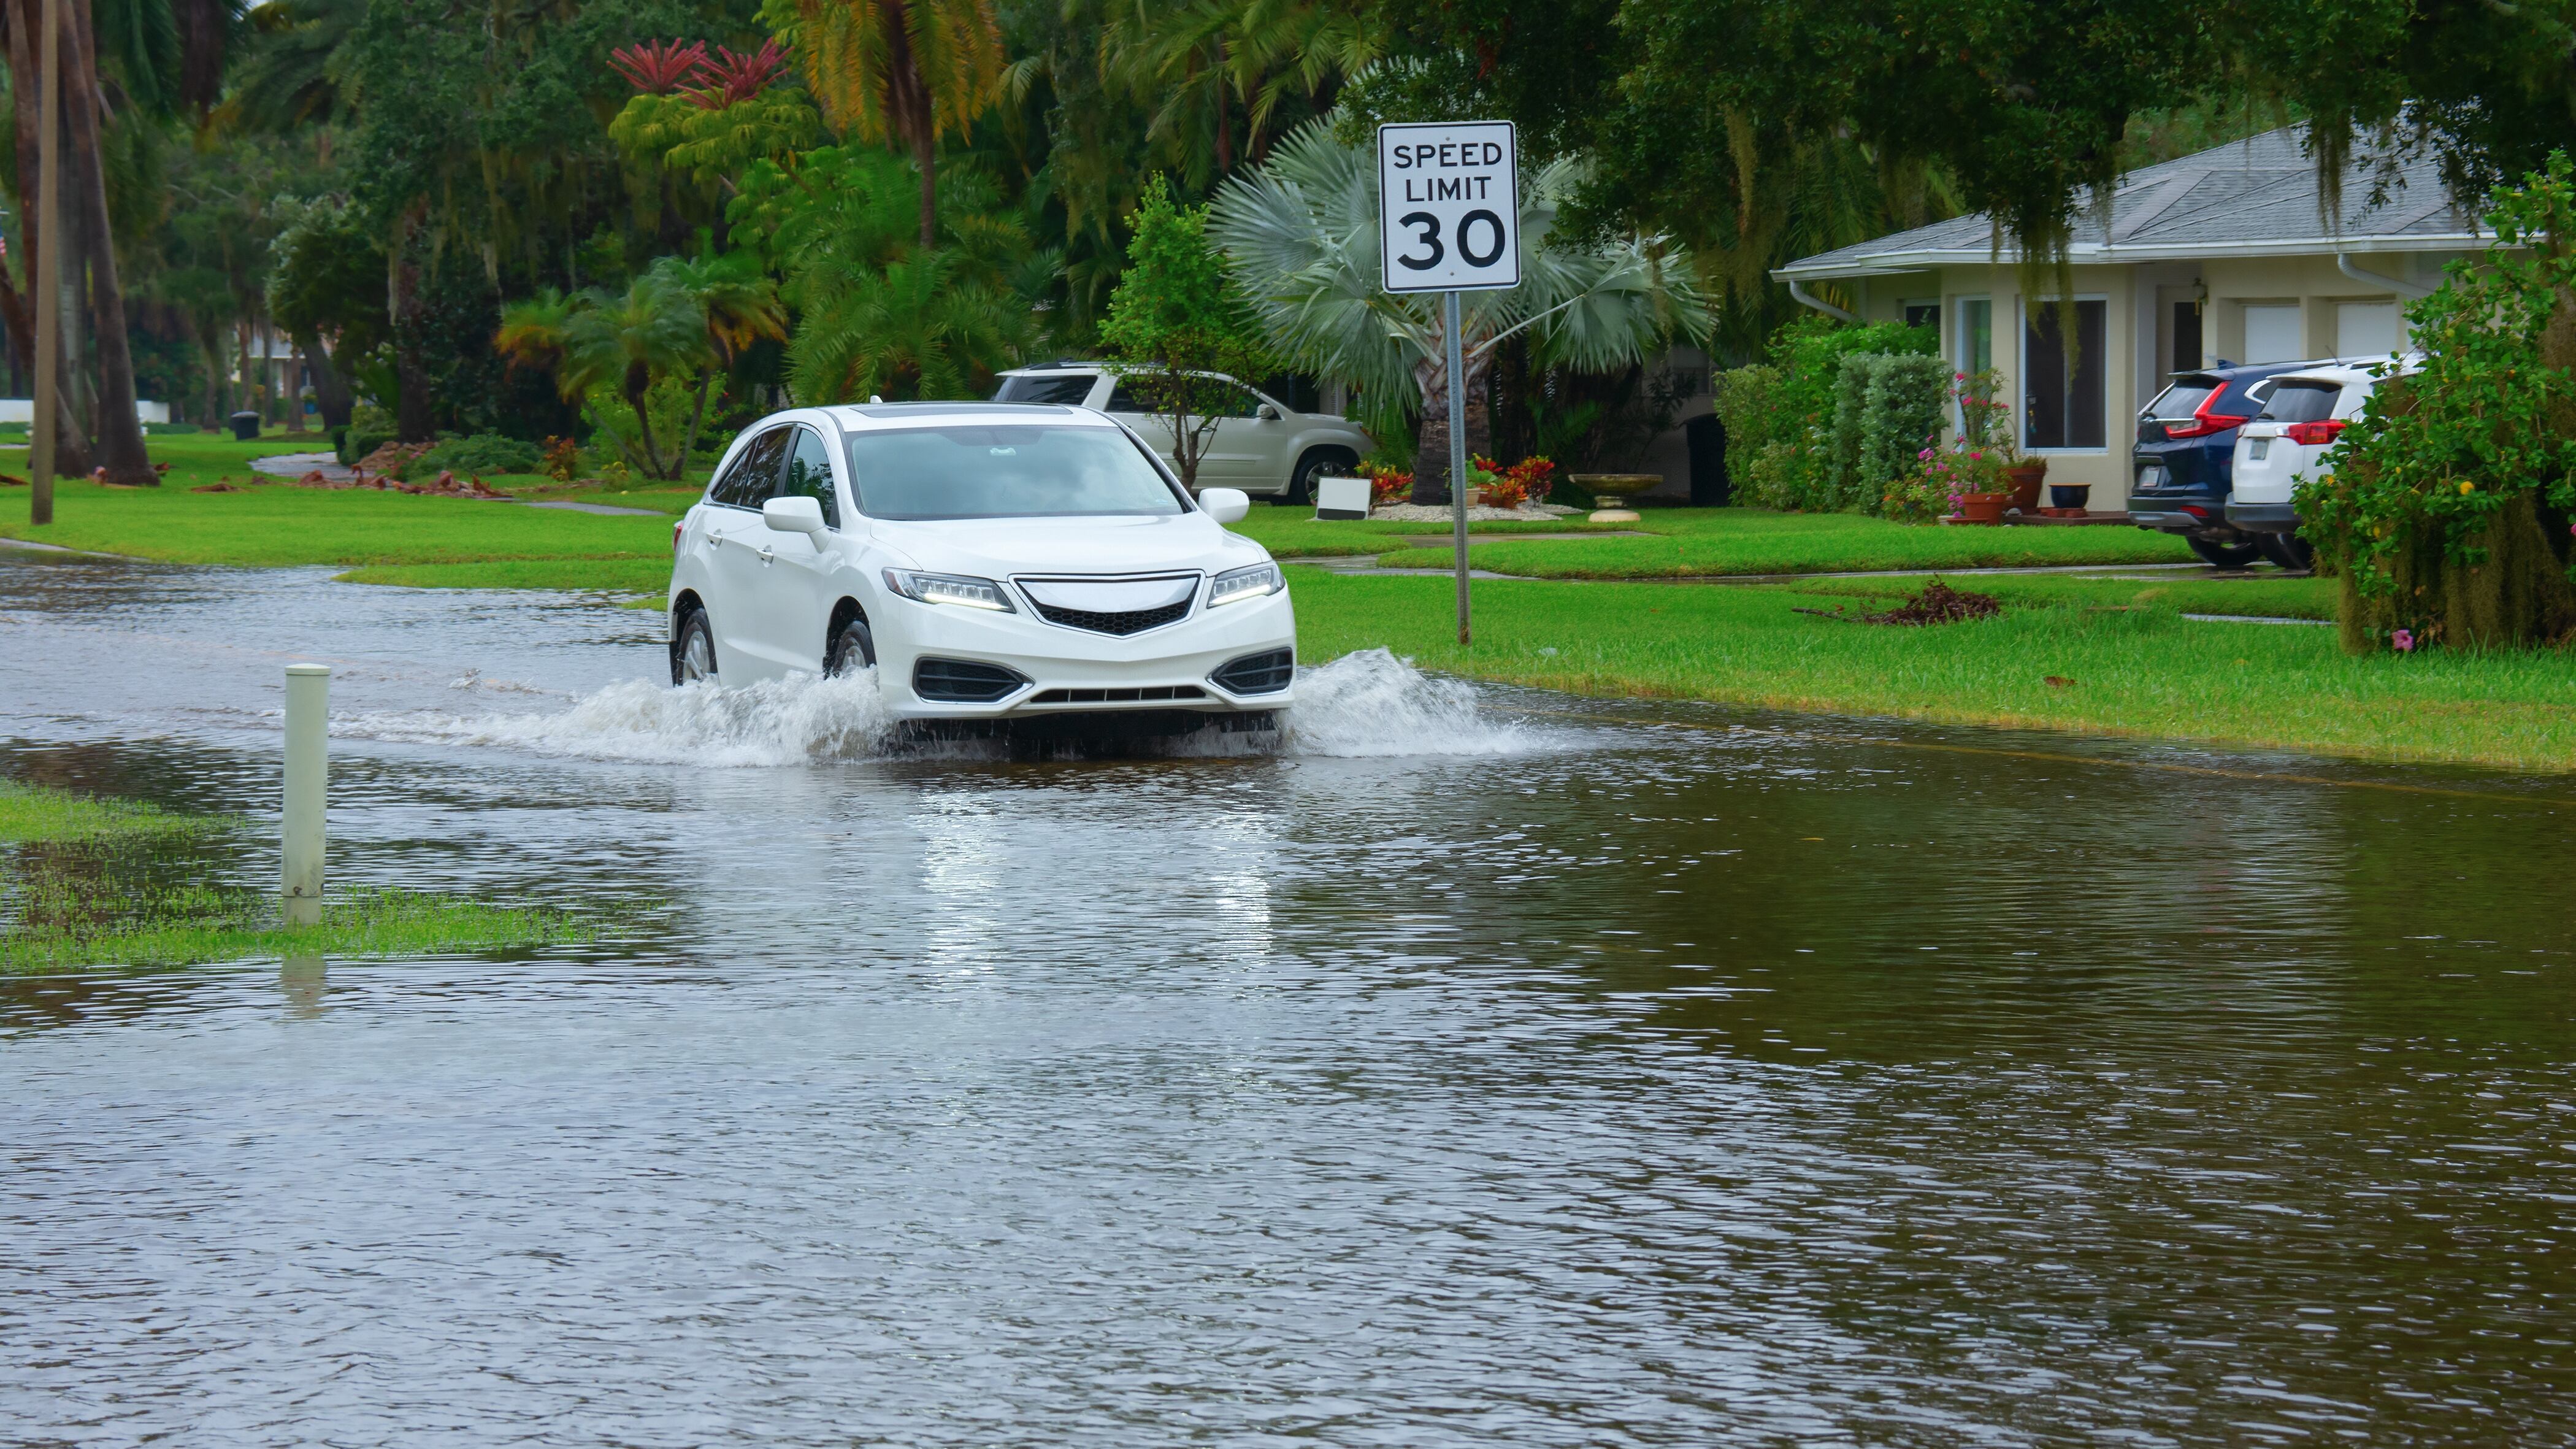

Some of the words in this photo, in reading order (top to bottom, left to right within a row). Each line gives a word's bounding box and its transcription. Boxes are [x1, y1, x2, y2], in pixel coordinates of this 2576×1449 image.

[1393, 142, 1502, 169] SPEED
[1406, 176, 1491, 202] LIMIT
[1397, 209, 1506, 271] 30
